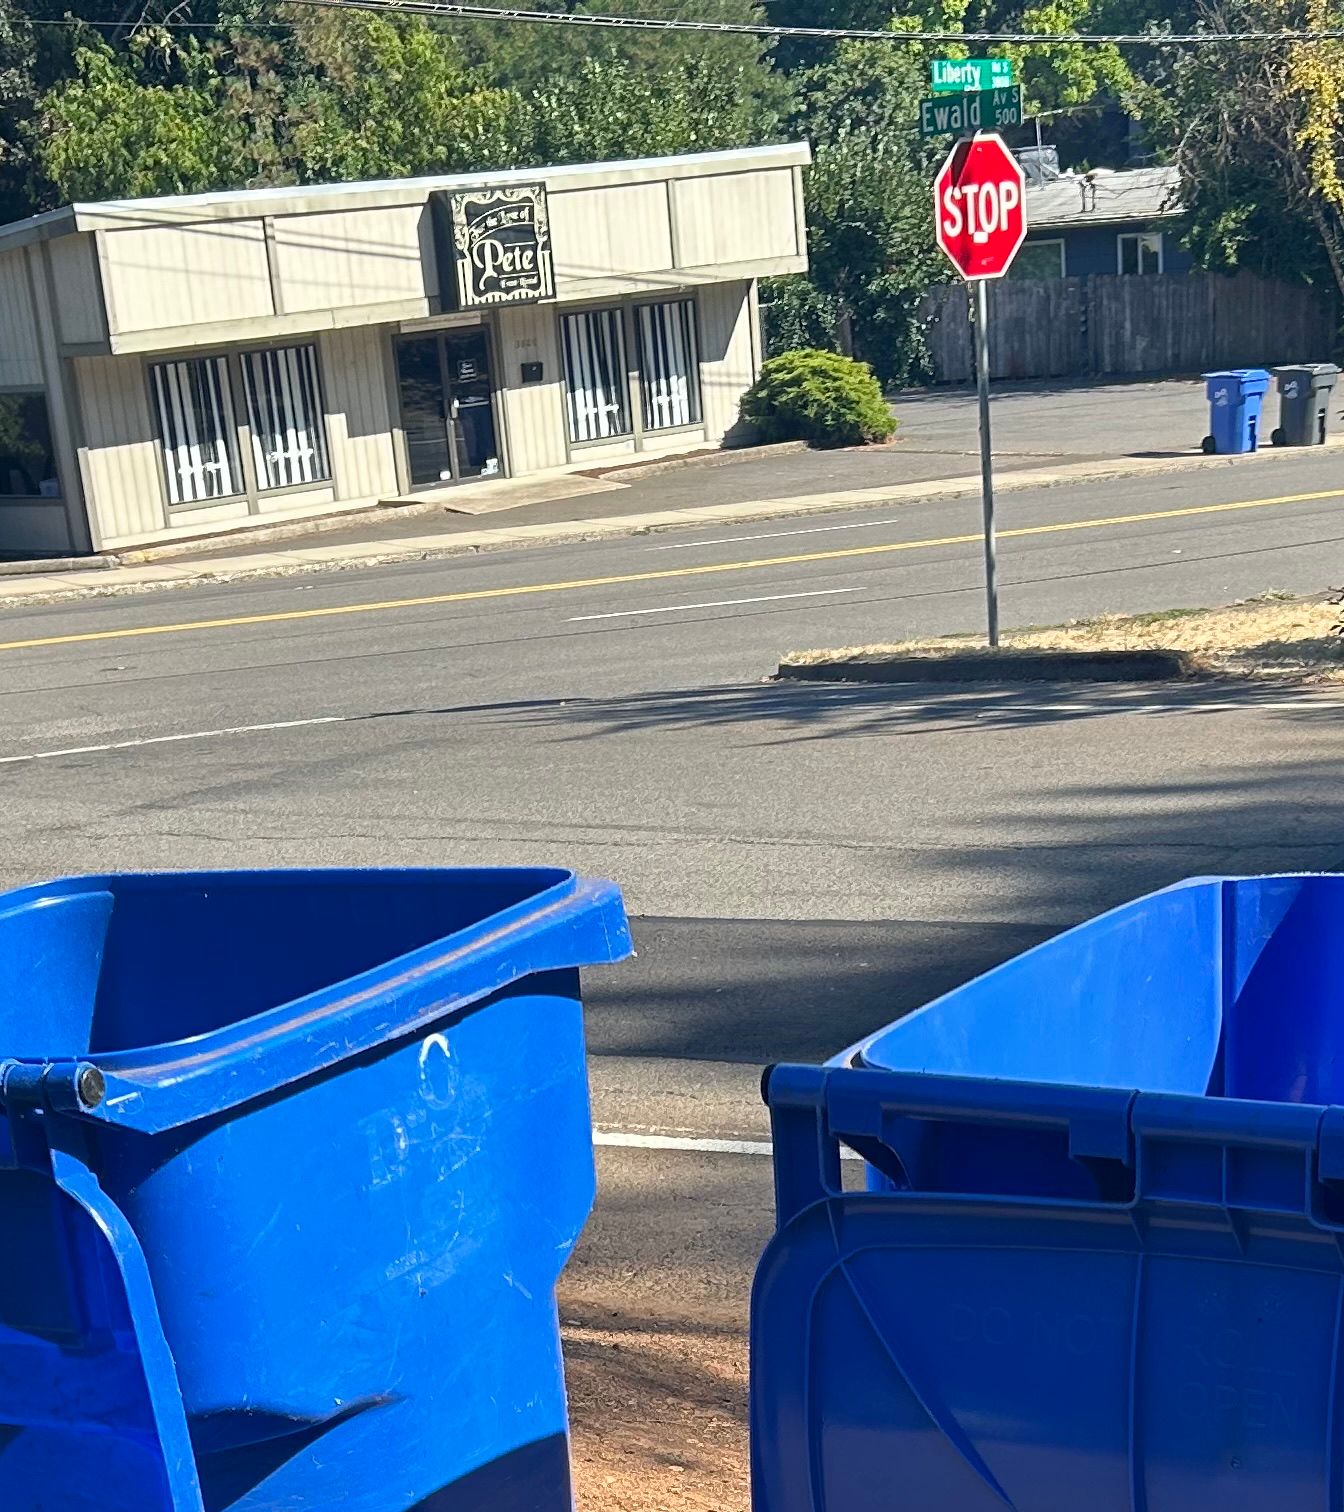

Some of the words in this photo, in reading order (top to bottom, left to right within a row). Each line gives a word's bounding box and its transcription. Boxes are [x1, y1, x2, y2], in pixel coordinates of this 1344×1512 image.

[933, 61, 981, 89] Liberty
[921, 95, 981, 133] Ewald
[992, 90, 1007, 106] Av
[1011, 88, 1019, 103] S
[995, 107, 1017, 125] 500
[943, 180, 1019, 238] STOP
[472, 239, 534, 291] Pete
